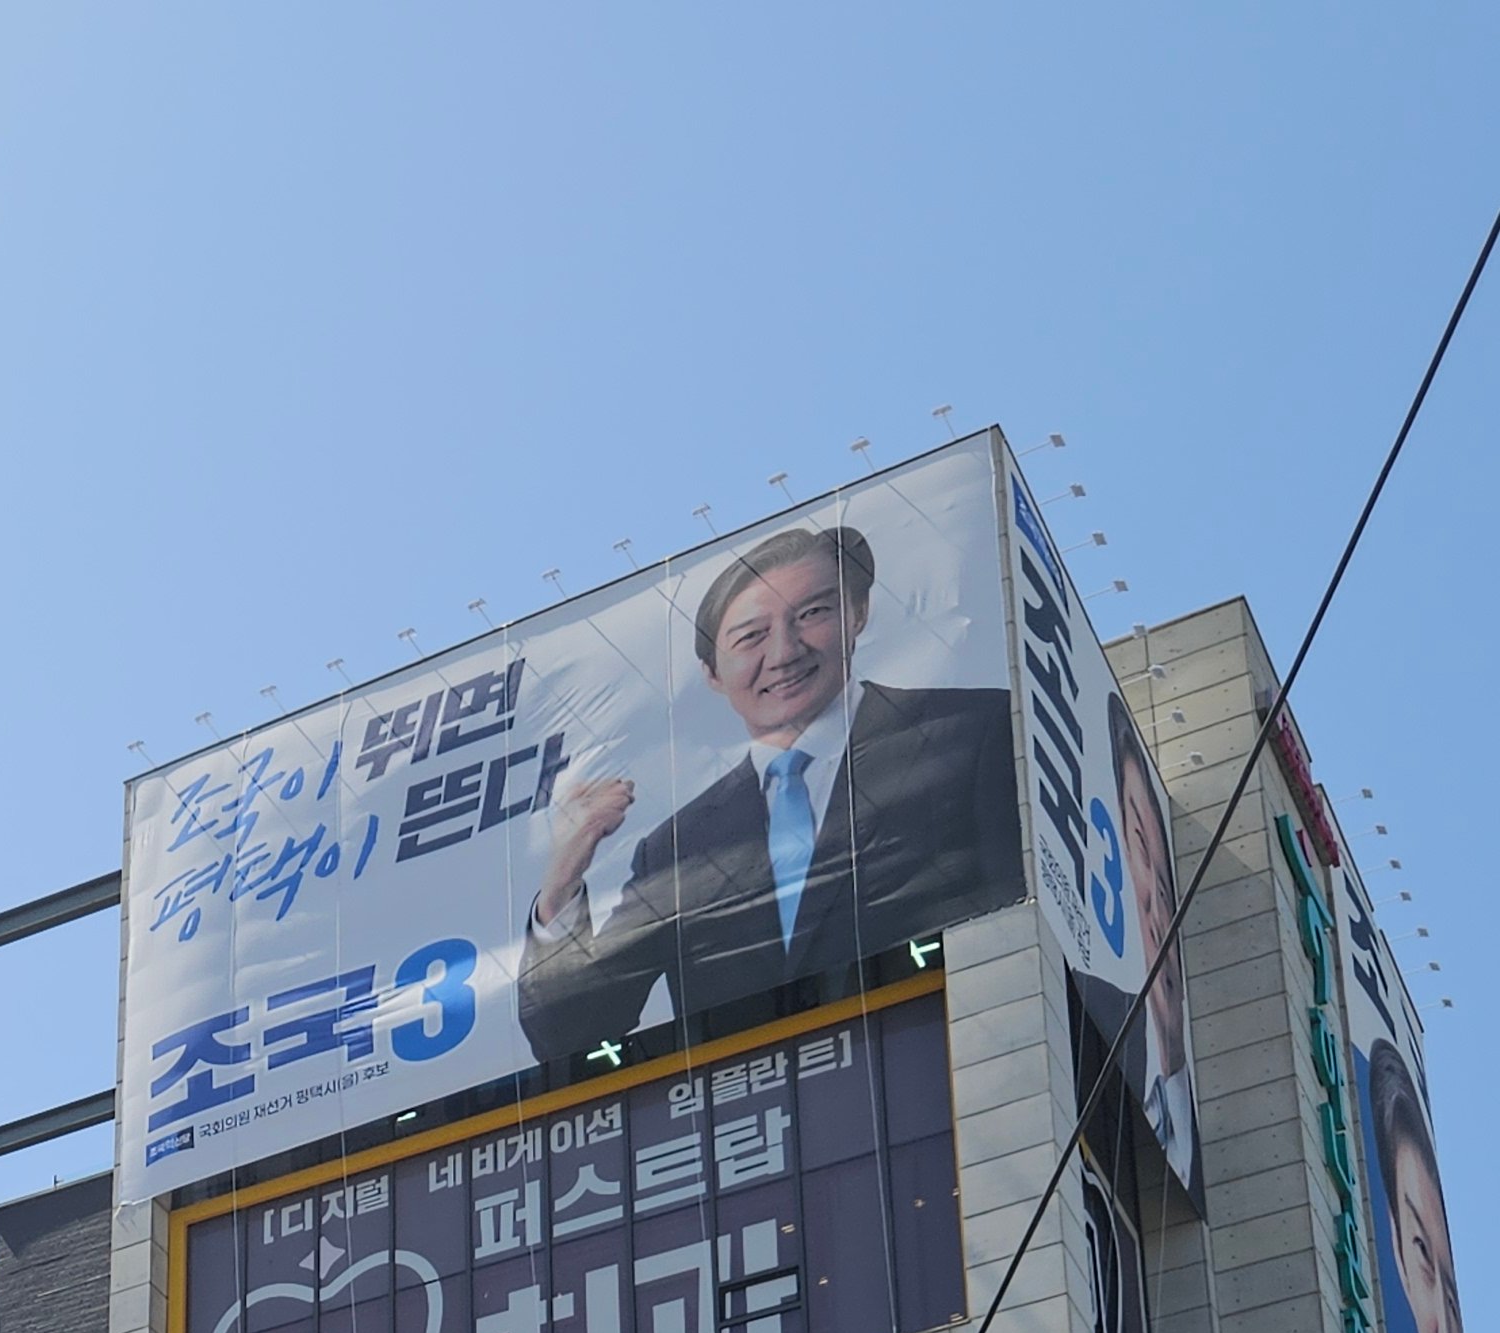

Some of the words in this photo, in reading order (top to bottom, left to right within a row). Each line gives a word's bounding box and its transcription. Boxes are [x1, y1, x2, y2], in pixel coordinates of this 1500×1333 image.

[150, 814, 378, 942] 평택이
[396, 731, 570, 863] 뜬다
[166, 742, 341, 853] 조국이
[353, 658, 527, 777] 뛰면
[1090, 796, 1124, 959] 3
[147, 963, 378, 1133] 조국
[390, 936, 478, 1064] 3
[198, 1110, 251, 1138] 국회의원
[253, 1095, 293, 1120] 재선거
[296, 1071, 360, 1104] 평택시(을)
[362, 1060, 390, 1082] 후보
[474, 1112, 790, 1260] 퍼스트탑
